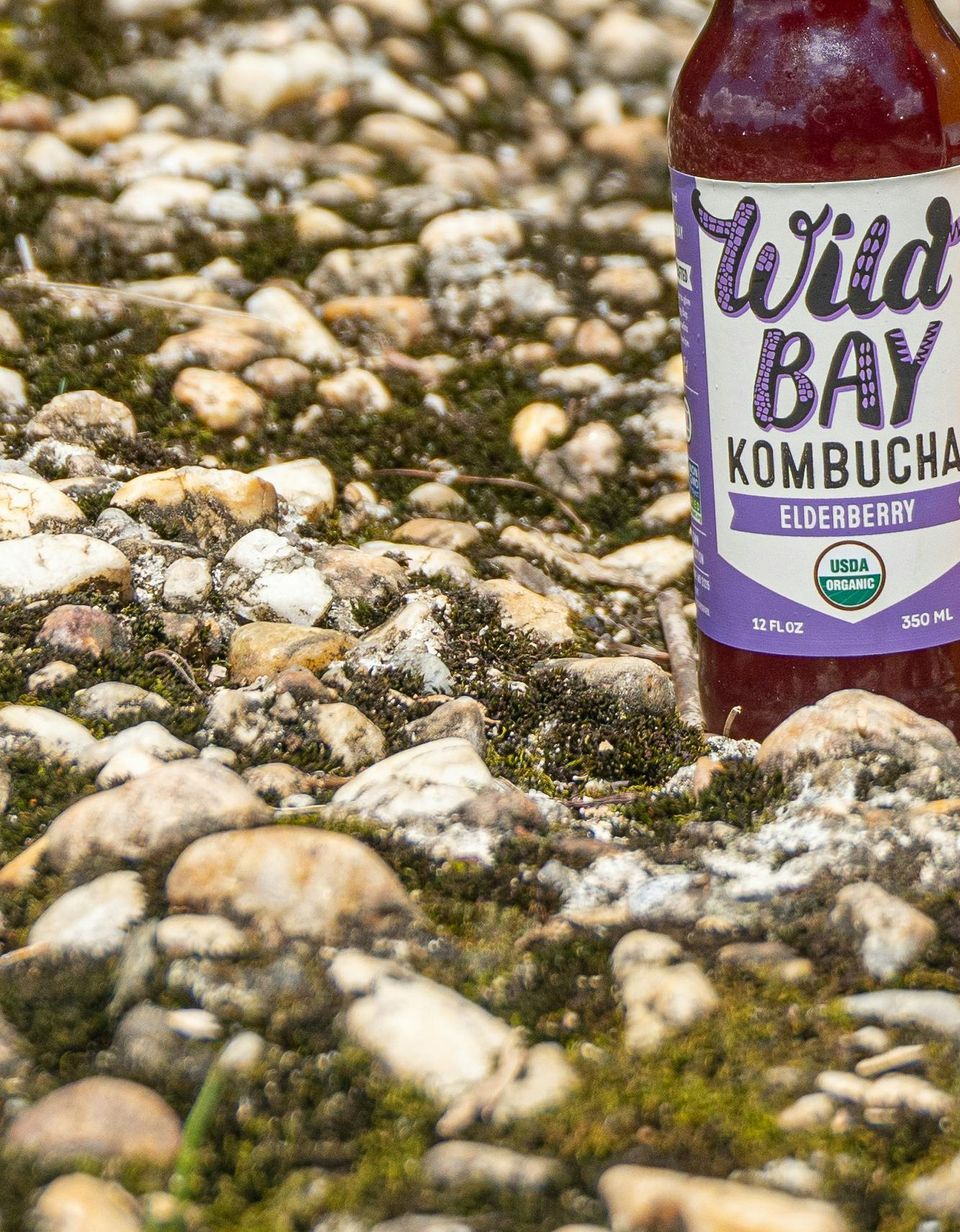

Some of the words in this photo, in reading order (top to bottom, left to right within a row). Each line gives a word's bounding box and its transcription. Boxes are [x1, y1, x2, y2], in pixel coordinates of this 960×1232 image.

[752, 320, 943, 432] BAY
[780, 499, 916, 529] ELDERBERRY
[830, 558, 869, 574] USDA
[825, 577, 875, 591] ORGANIC
[752, 617, 767, 631] 12
[901, 613, 929, 629] 350
[933, 608, 953, 622] ML
